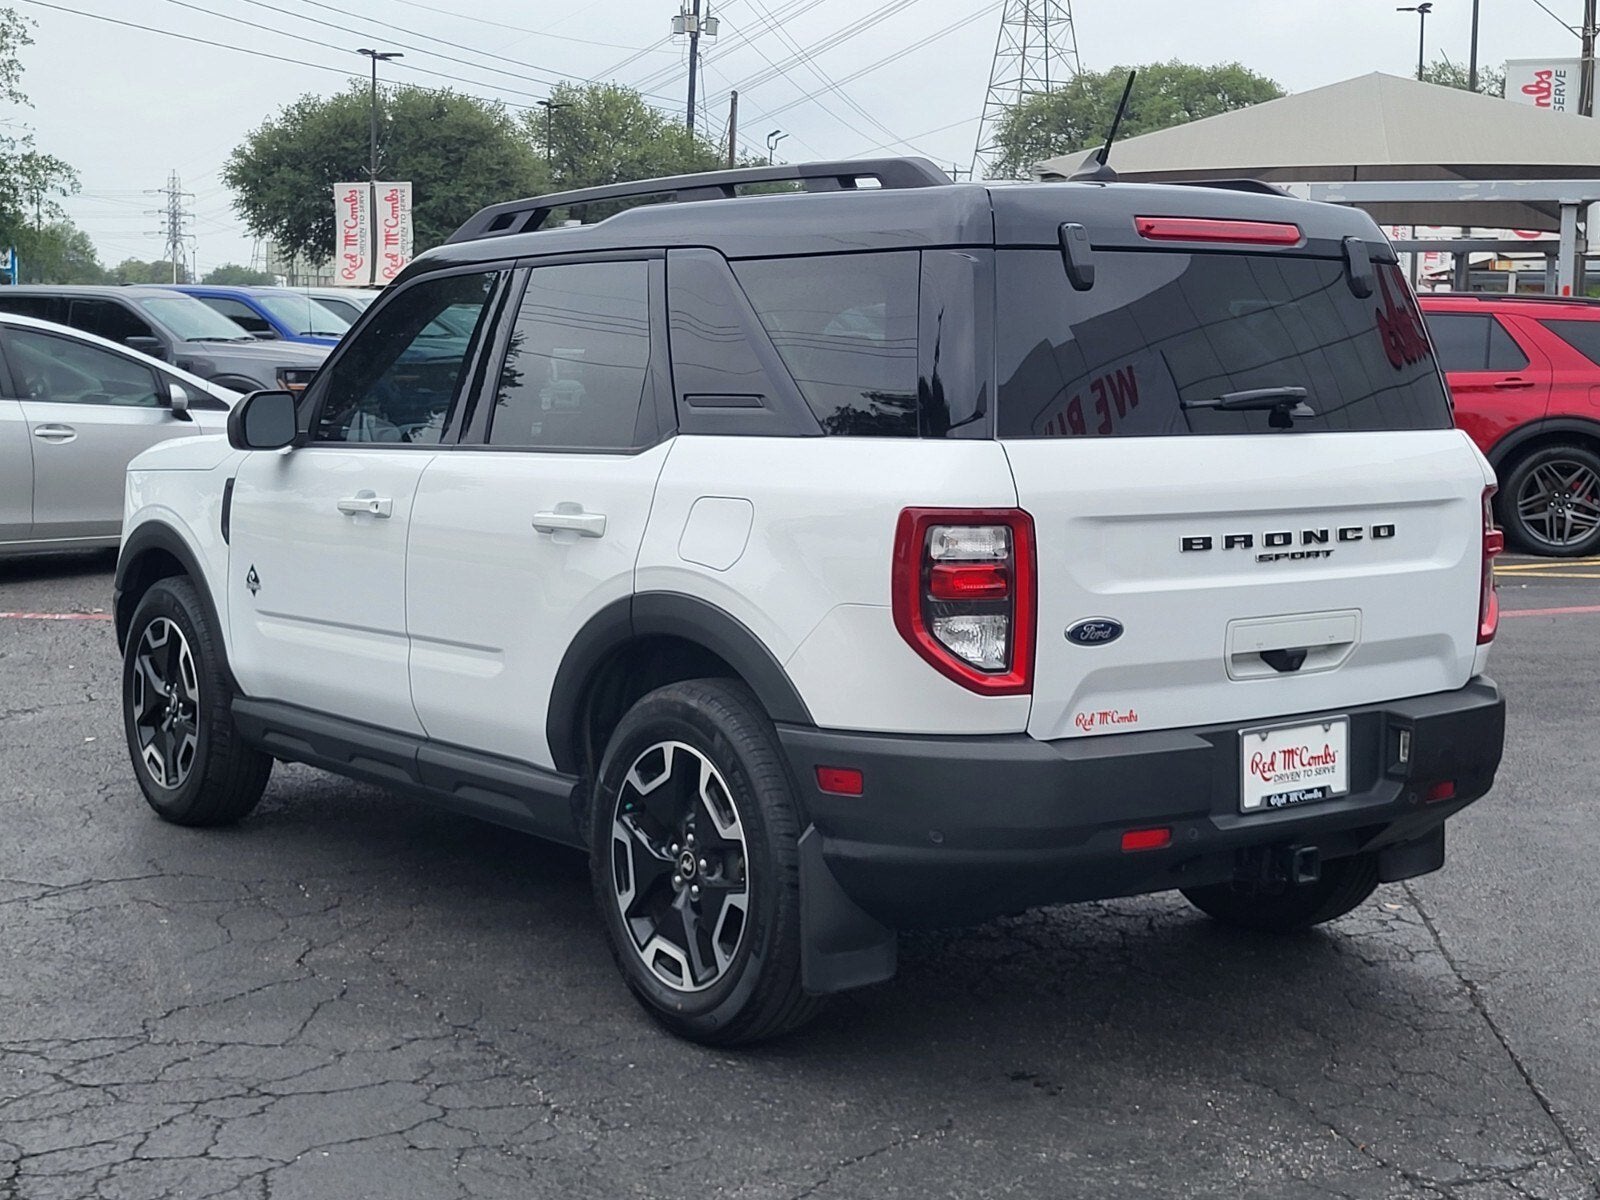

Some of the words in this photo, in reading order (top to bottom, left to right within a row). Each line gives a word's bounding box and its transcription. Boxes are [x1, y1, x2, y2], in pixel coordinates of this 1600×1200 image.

[1553, 70, 1566, 112] SERVE
[343, 189, 358, 251] McCombs
[359, 215, 365, 225] TO
[384, 188, 399, 251] McCombs
[400, 214, 406, 224] TO
[341, 253, 363, 280] Red
[382, 253, 404, 279] Red
[1179, 524, 1396, 553] BRONCO
[1255, 549, 1335, 563] SPORT
[1080, 623, 1112, 641] Ford
[1075, 712, 1096, 731] Red
[1097, 709, 1138, 725] McCombs
[1250, 751, 1277, 782] Red
[1279, 743, 1337, 771] McCombs
[1273, 771, 1301, 783] DRIVEN
[1303, 768, 1313, 779] TO
[1314, 765, 1336, 777] SERVE
[1270, 793, 1287, 807] Red
[1288, 788, 1323, 803] McCombs
